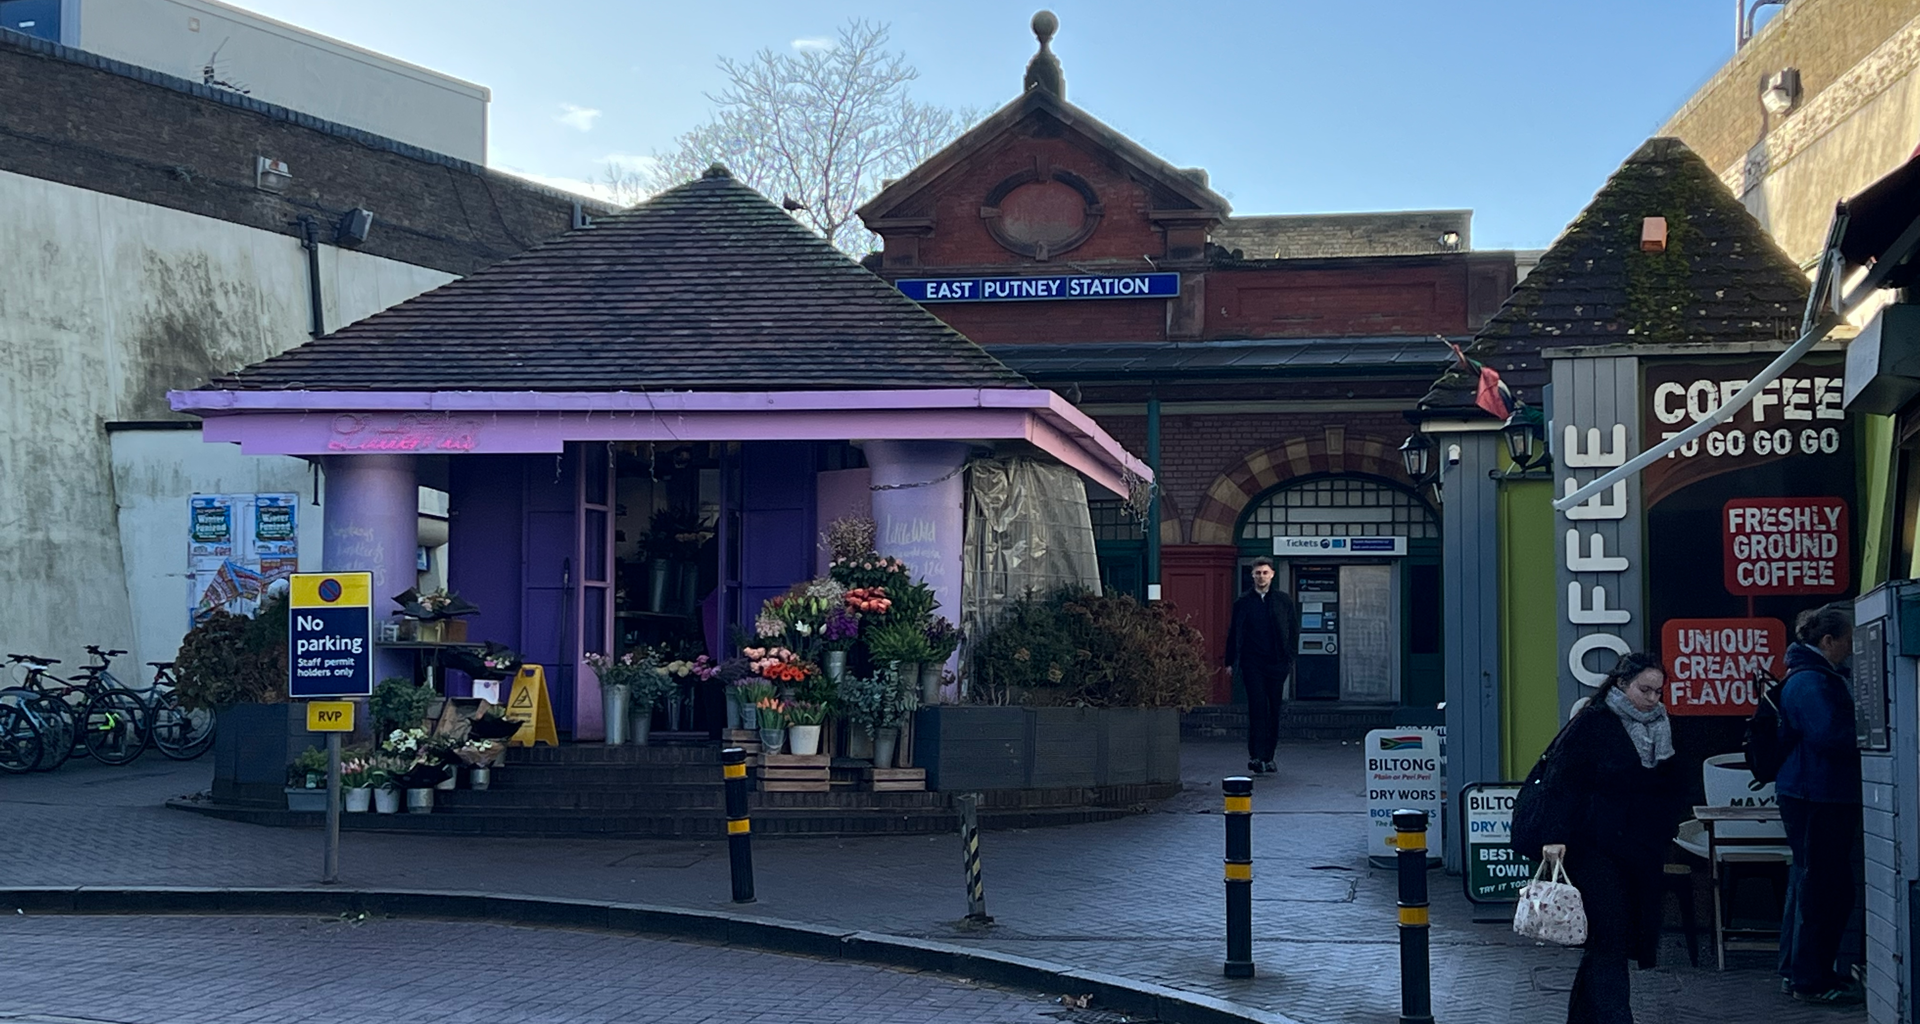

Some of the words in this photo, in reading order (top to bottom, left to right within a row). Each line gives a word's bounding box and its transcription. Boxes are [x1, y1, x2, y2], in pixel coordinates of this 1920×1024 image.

[926, 282, 973, 299] EAST
[984, 279, 1061, 297] PUTNEY
[1070, 277, 1149, 296] STATION
[1654, 377, 1845, 425] COFFEE
[1706, 429, 1746, 456] GO
[1753, 428, 1793, 455] GO
[1800, 427, 1840, 454] GO
[1728, 505, 1842, 533] FRESHLY
[1286, 539, 1318, 548] Tickets
[1733, 533, 1838, 560] GROUND
[1564, 423, 1631, 720] OFFEE
[1736, 560, 1835, 586] COFFEE
[297, 615, 324, 631] No
[297, 635, 363, 655] parking
[1678, 628, 1769, 655] UNIQUE
[297, 658, 321, 667] Staff
[324, 657, 355, 668] permit
[1674, 655, 1775, 681] CREAMY
[297, 668, 331, 677] holders
[334, 667, 354, 678] only
[1670, 680, 1759, 707] FLAVOU
[318, 711, 342, 722] RVP
[1369, 758, 1436, 771] BILTONG
[1373, 773, 1392, 781] Plain
[1370, 790, 1395, 800] DRY
[1398, 789, 1436, 801] WORS
[1470, 796, 1515, 811] BILTO
[1471, 821, 1497, 833] DRY
[1480, 848, 1514, 861] BEST
[1486, 864, 1530, 877] TOWN
[1479, 885, 1495, 895] TRY
[1498, 882, 1507, 891] IT
